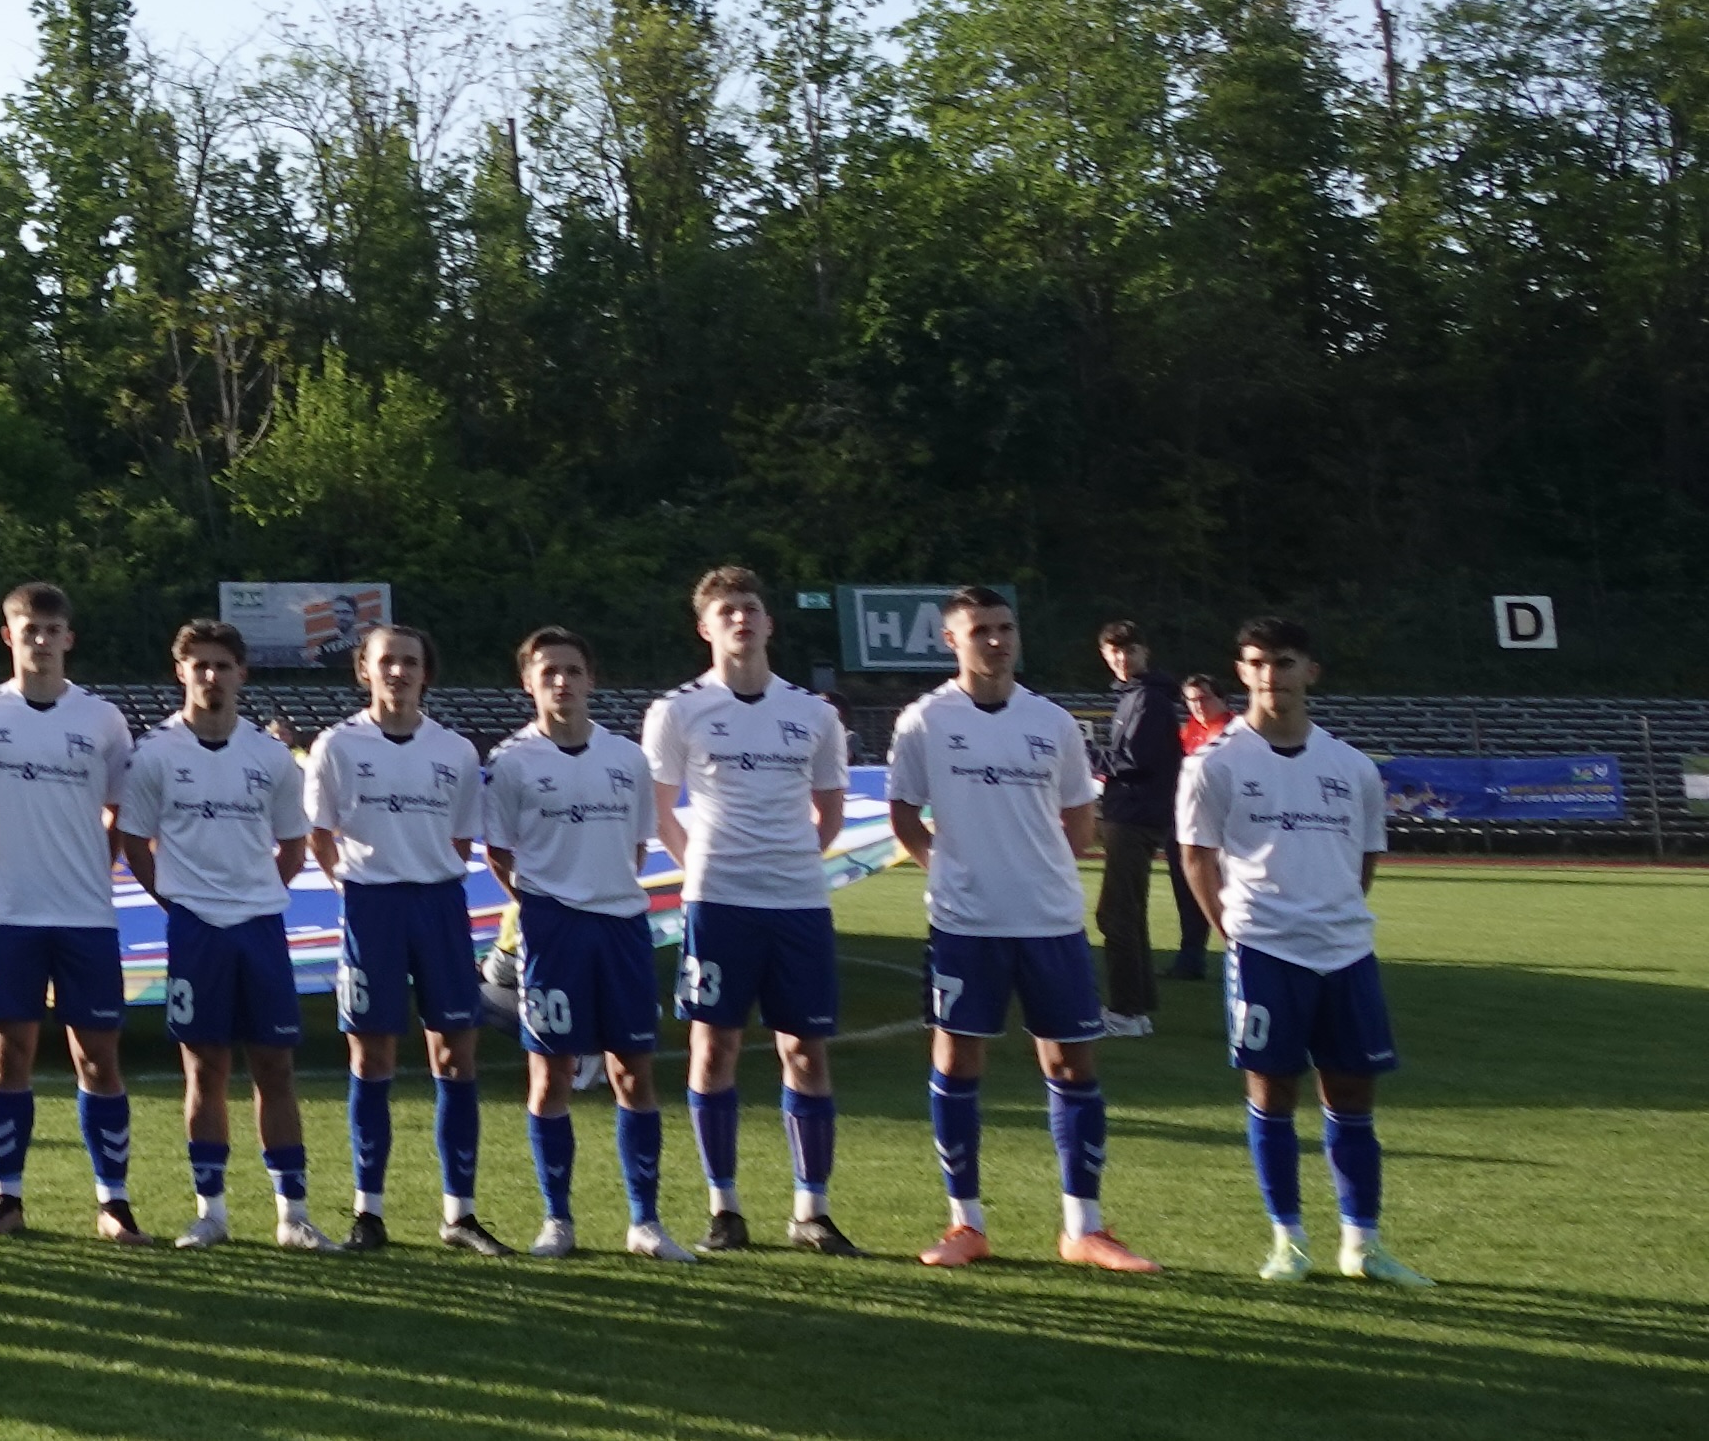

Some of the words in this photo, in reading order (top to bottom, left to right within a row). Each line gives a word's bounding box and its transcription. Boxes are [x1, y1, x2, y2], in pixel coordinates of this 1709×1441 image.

[866, 602, 954, 654] HA
[1506, 603, 1544, 641] D
[526, 987, 572, 1034] 20
